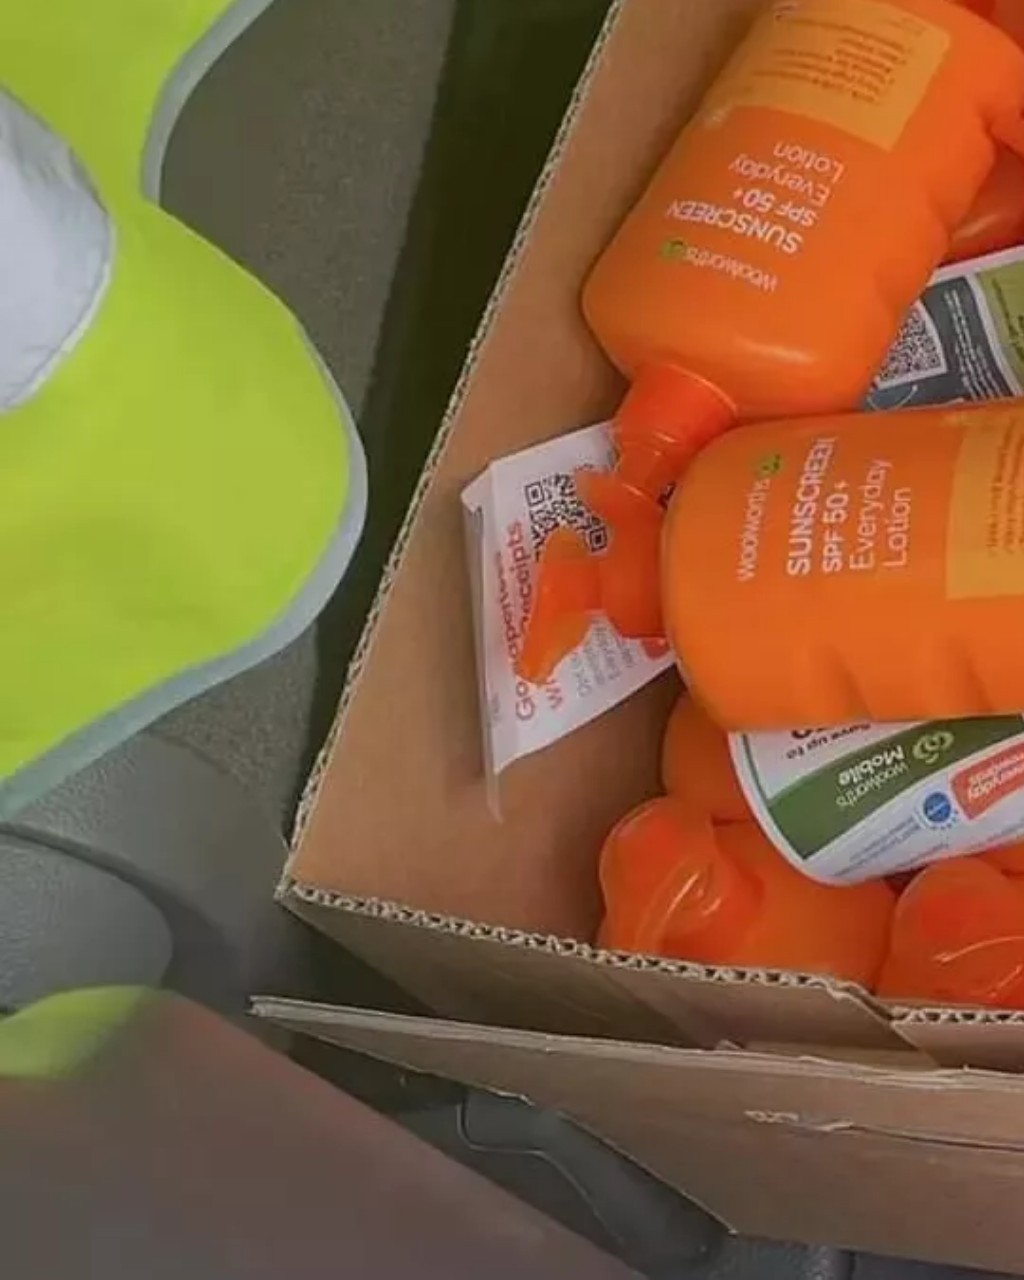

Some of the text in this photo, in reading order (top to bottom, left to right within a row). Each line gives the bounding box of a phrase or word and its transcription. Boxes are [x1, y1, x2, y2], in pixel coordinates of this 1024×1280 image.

[728, 153, 831, 207] Everyday
[773, 141, 845, 183] Lotion
[667, 200, 803, 253] SUNSCREEN
[732, 187, 817, 227] SPF 50+
[822, 480, 849, 572] SPF 50+
[849, 458, 893, 570] Everyday
[882, 486, 912, 567] Lotion
[838, 745, 905, 786] Mobile
